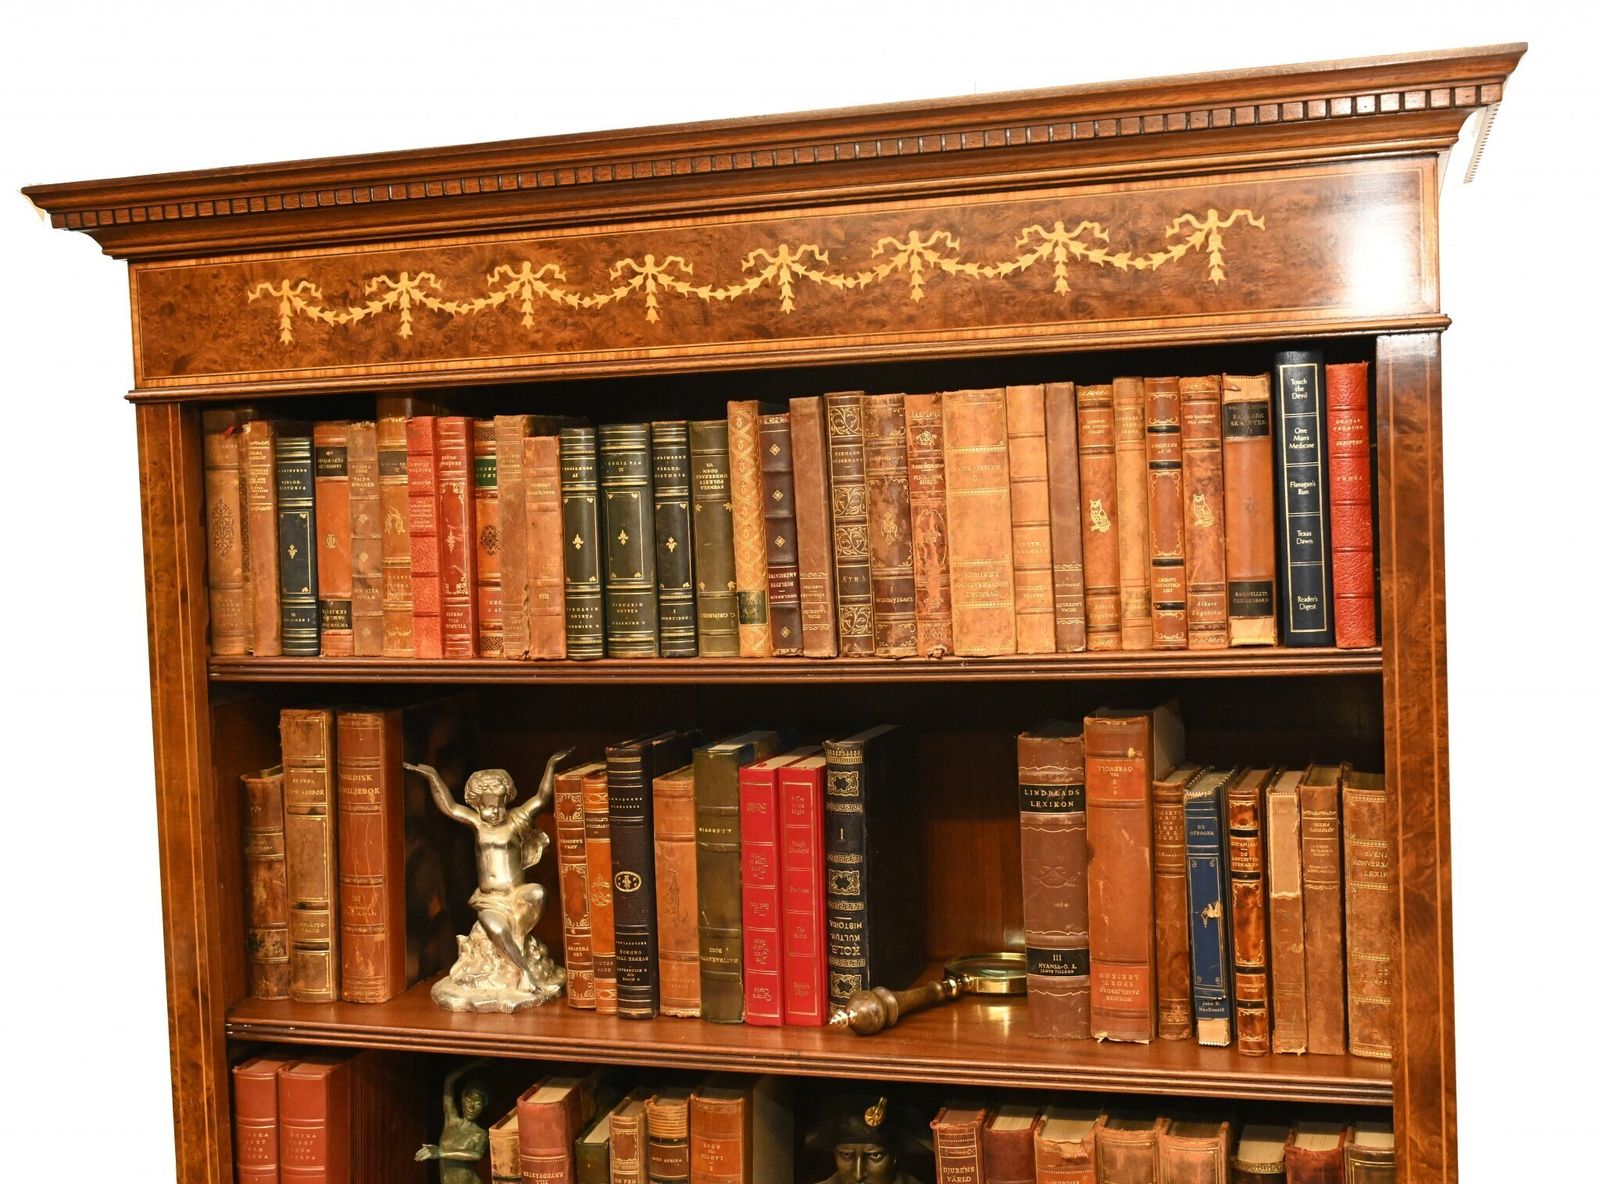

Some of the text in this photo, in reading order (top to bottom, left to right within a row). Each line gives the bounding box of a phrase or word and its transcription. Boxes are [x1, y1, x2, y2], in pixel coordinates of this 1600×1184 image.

[1290, 377, 1308, 386] Touch
[1294, 385, 1305, 393] the
[1291, 392, 1308, 400] Devil
[1294, 426, 1308, 435] One
[1293, 434, 1310, 443] Man's
[1288, 442, 1315, 450] Medicine
[1290, 480, 1317, 489] Flanagan's
[1297, 488, 1310, 496] Run
[1296, 529, 1313, 537] Texas
[1296, 537, 1314, 545] Dawn
[1296, 594, 1319, 603] Reader's
[1299, 602, 1317, 611] Digest
[1030, 800, 1076, 808] LEXIKON
[1052, 953, 1063, 962] III
[942, 1166, 975, 1175] DJURENS
[946, 1176, 972, 1184] VÄRLD
